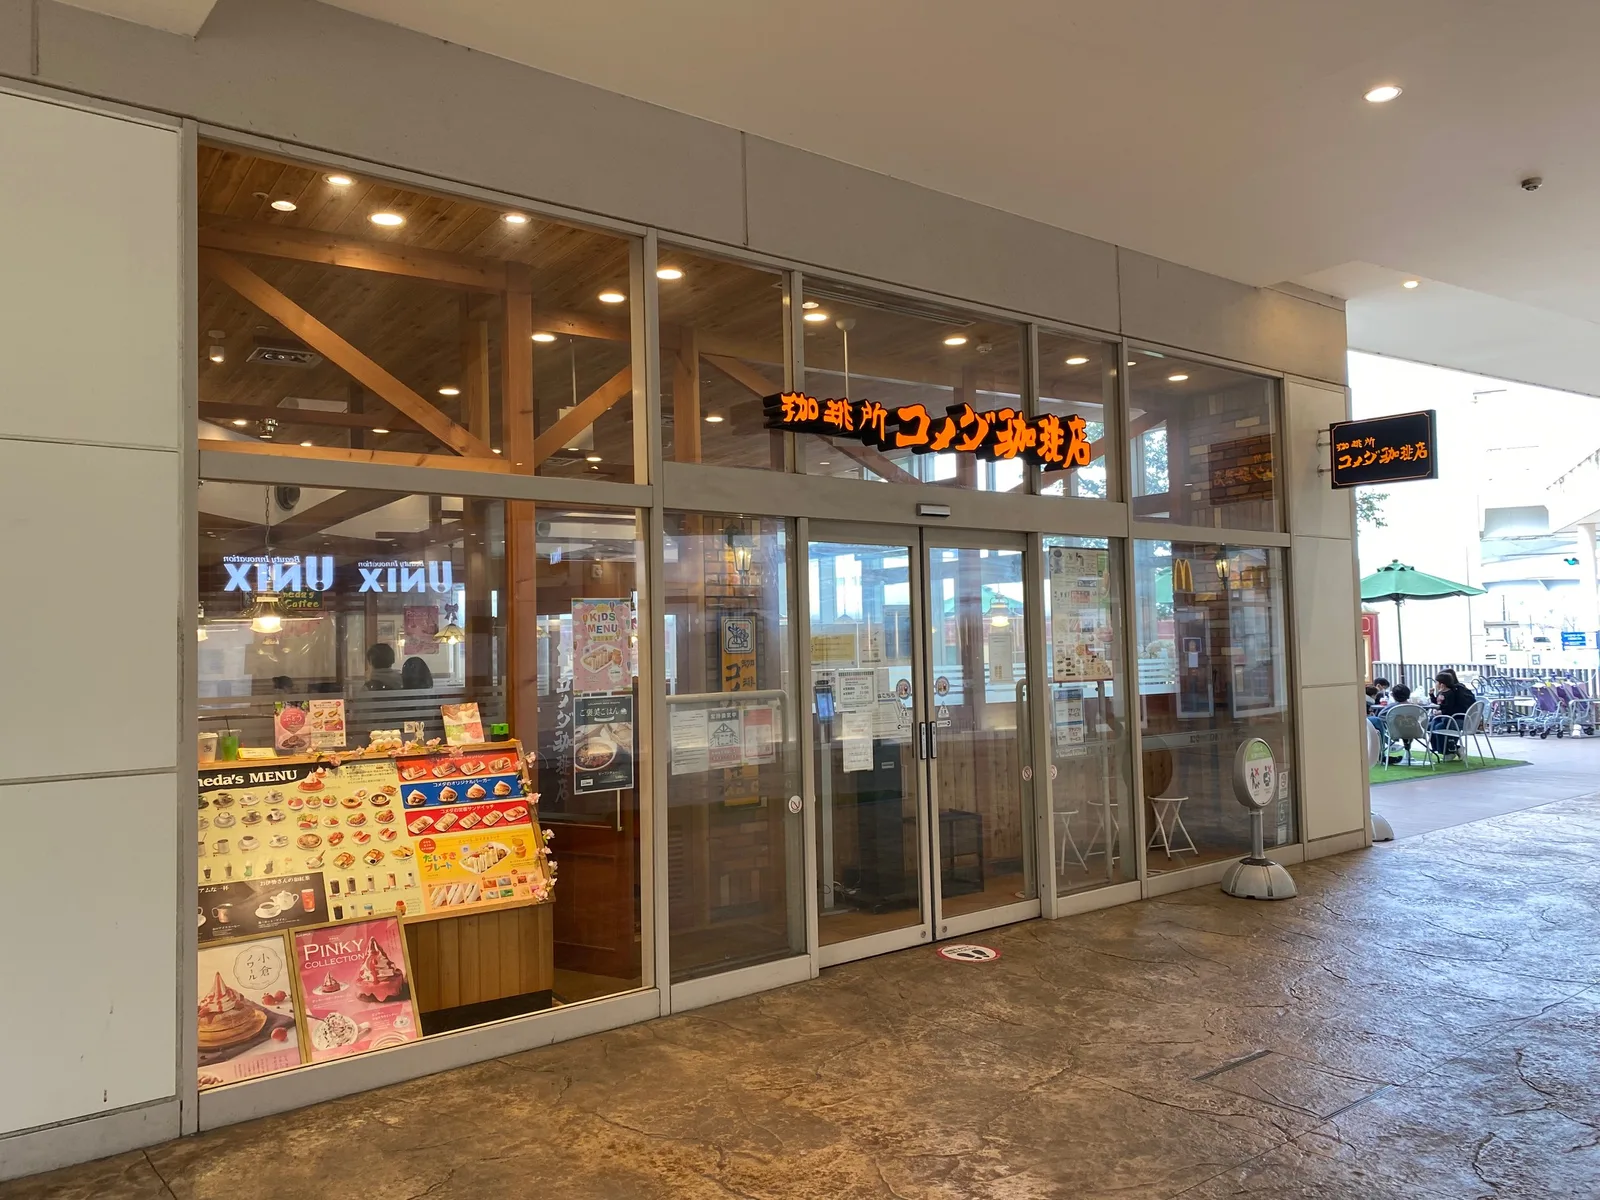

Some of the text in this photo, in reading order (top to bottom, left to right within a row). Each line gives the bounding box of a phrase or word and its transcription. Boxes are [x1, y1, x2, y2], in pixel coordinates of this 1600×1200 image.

[1338, 442, 1428, 470] コメダ珈琲店
[589, 612, 616, 623] KIDS
[588, 624, 618, 634] MENU
[249, 770, 298, 784] MENU
[423, 852, 457, 863] だいすき
[425, 861, 453, 872] プレート
[303, 939, 364, 961] PINKY
[246, 954, 257, 981] ノワール
[258, 953, 272, 977] 小倉
[304, 953, 366, 969] COLLECTION
